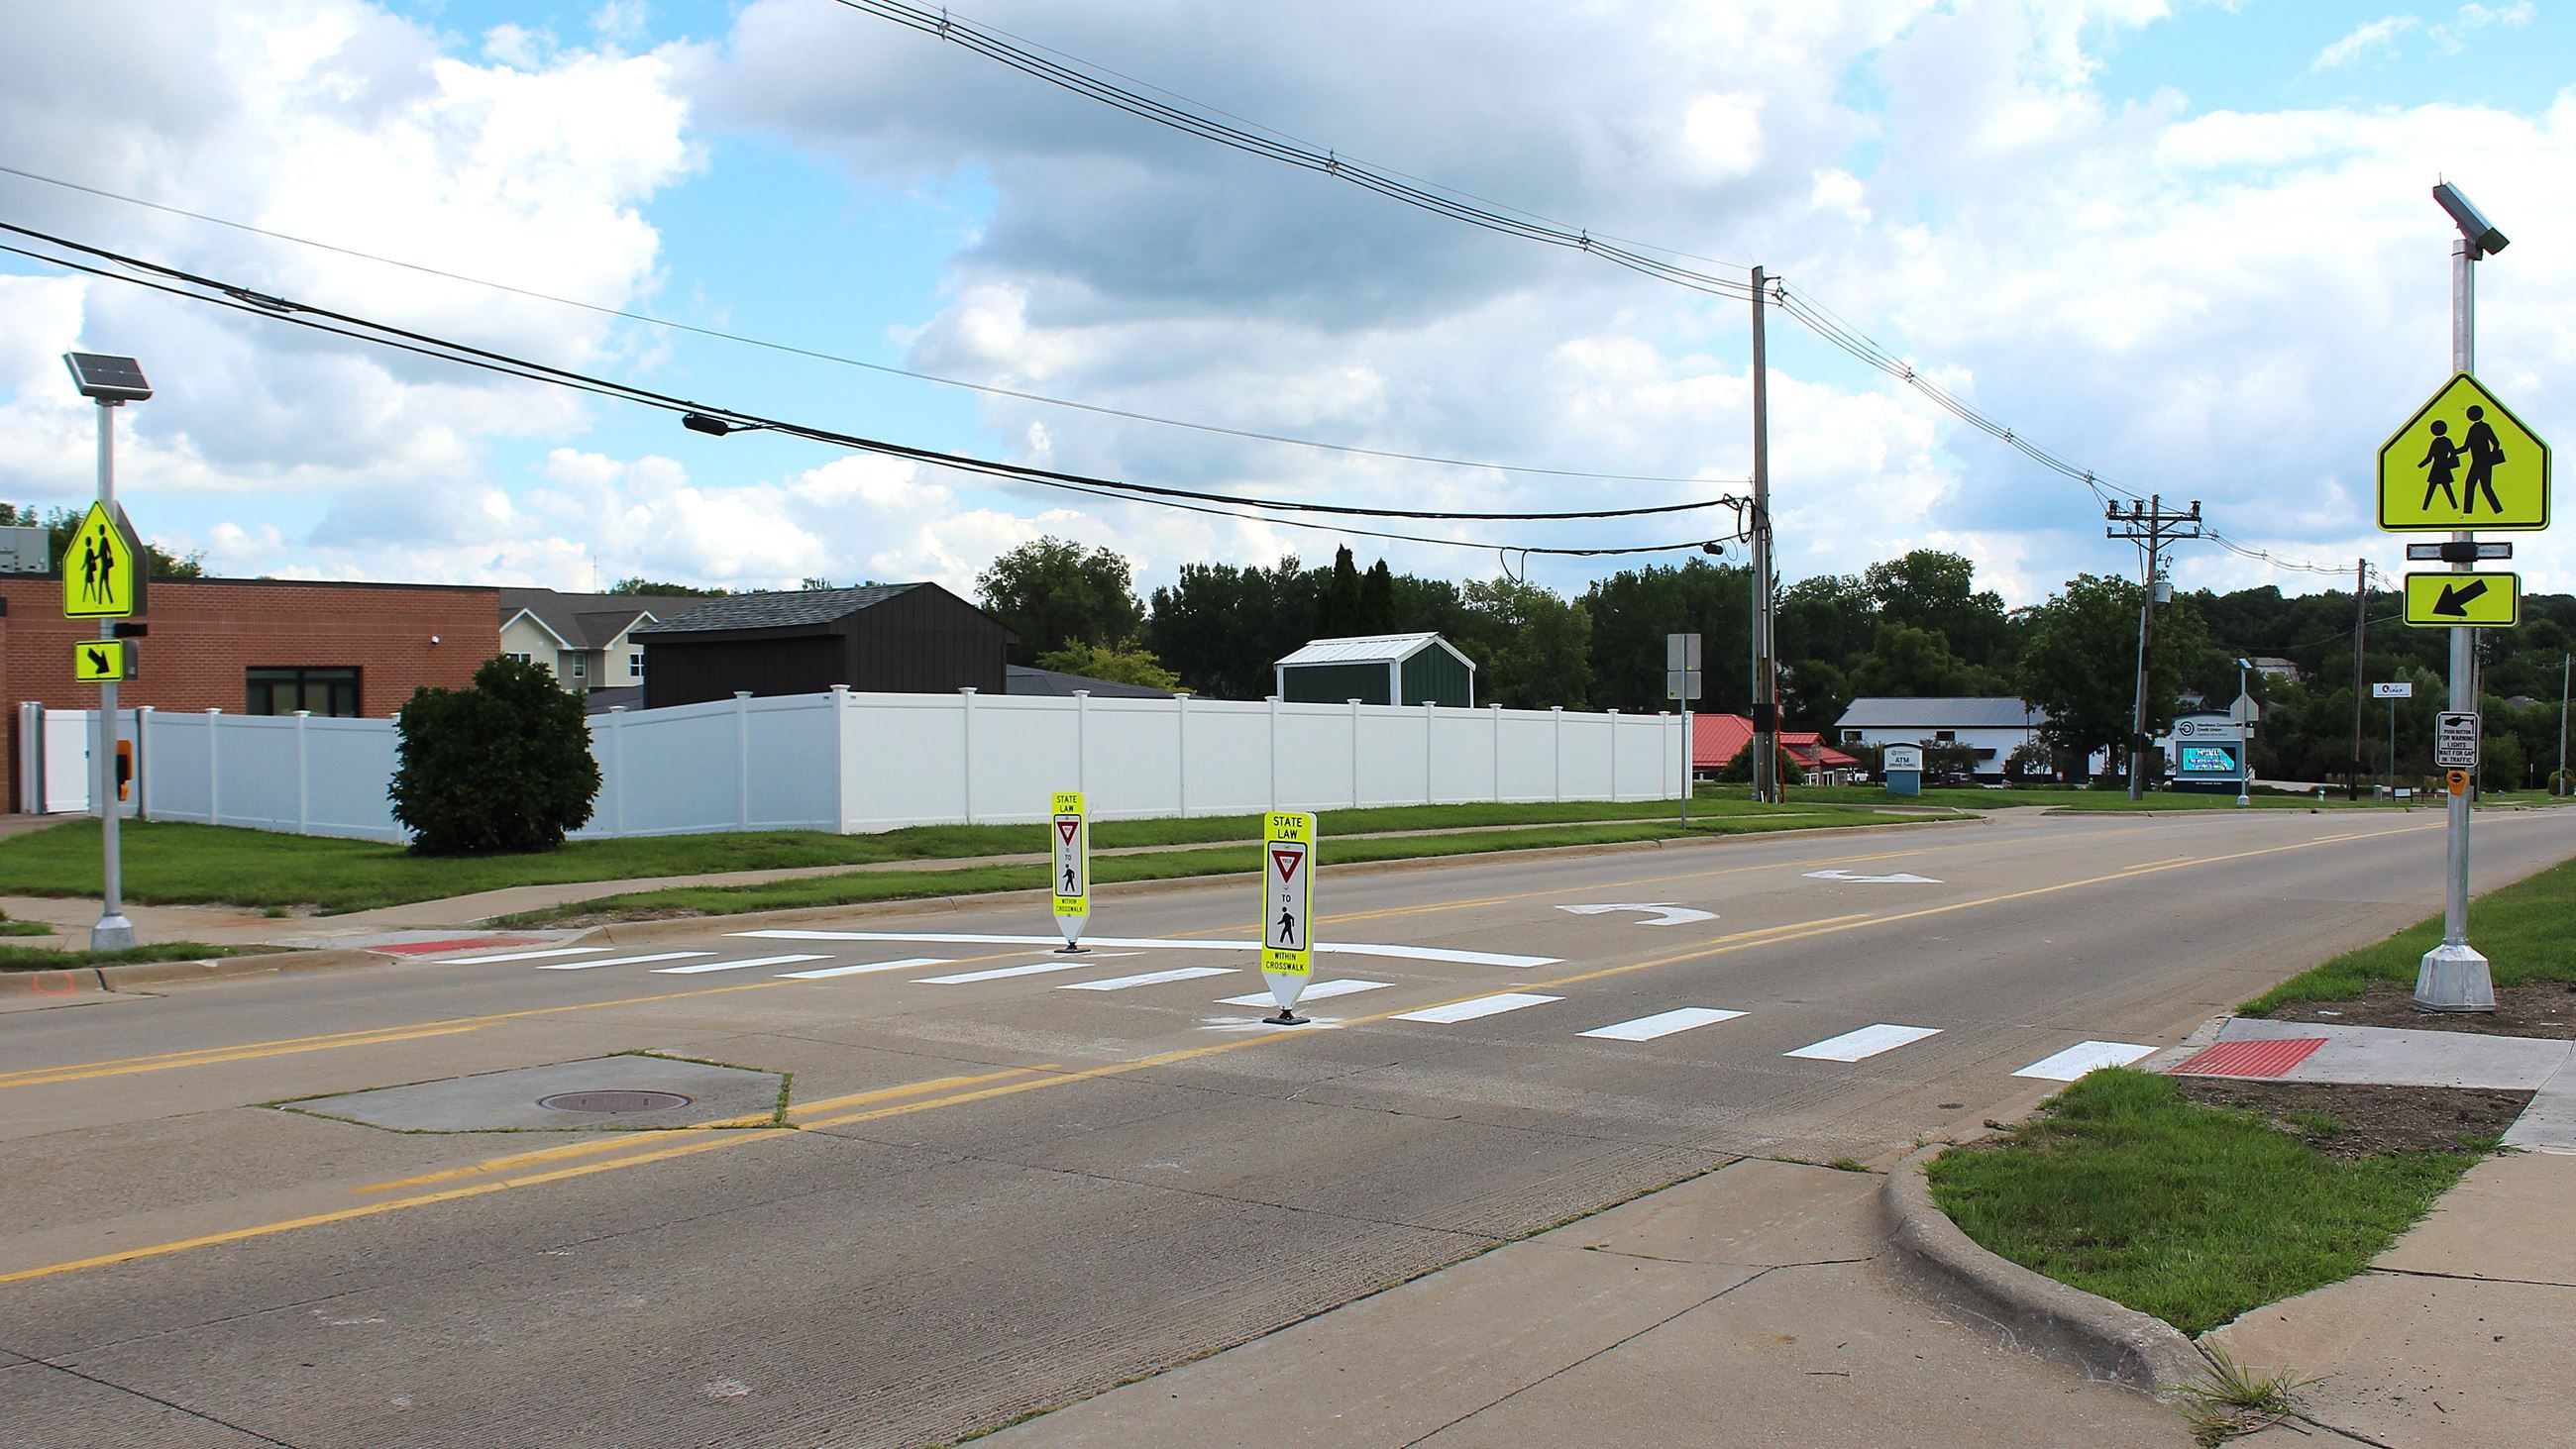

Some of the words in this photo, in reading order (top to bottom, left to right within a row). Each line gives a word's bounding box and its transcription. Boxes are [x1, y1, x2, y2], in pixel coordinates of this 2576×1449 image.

[1273, 816, 1303, 827] STATE
[1278, 829, 1298, 839] LAW
[1274, 952, 1296, 961] WITHIN
[1265, 961, 1305, 972] CROSSWALK
